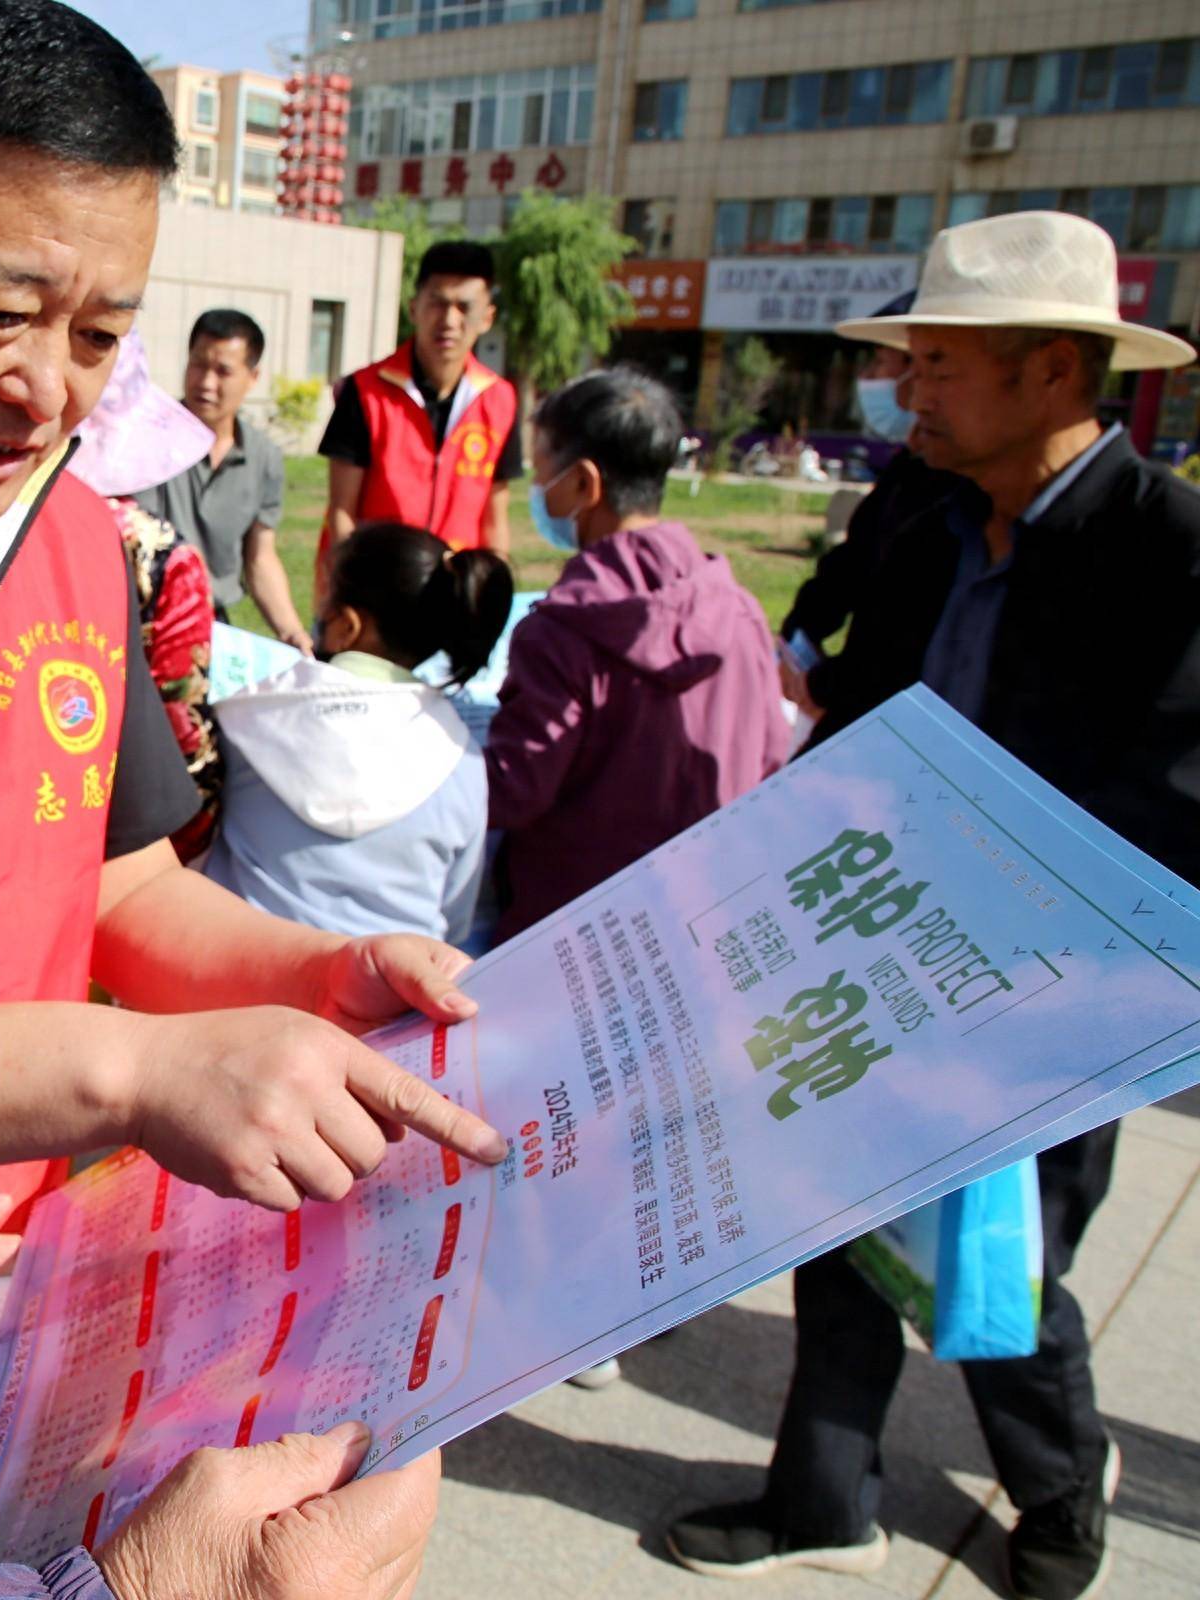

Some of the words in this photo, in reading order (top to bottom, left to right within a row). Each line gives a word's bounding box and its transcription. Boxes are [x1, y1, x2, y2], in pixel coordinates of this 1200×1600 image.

[785, 828, 933, 945] 保护
[713, 929, 763, 993] 地球故事
[744, 905, 797, 976] 讲好我们
[897, 906, 1014, 1014] PROTECT
[865, 953, 935, 1033] WETLANDS
[742, 968, 893, 1121] 湿地
[544, 1079, 579, 1180] 2024龙年大吉
